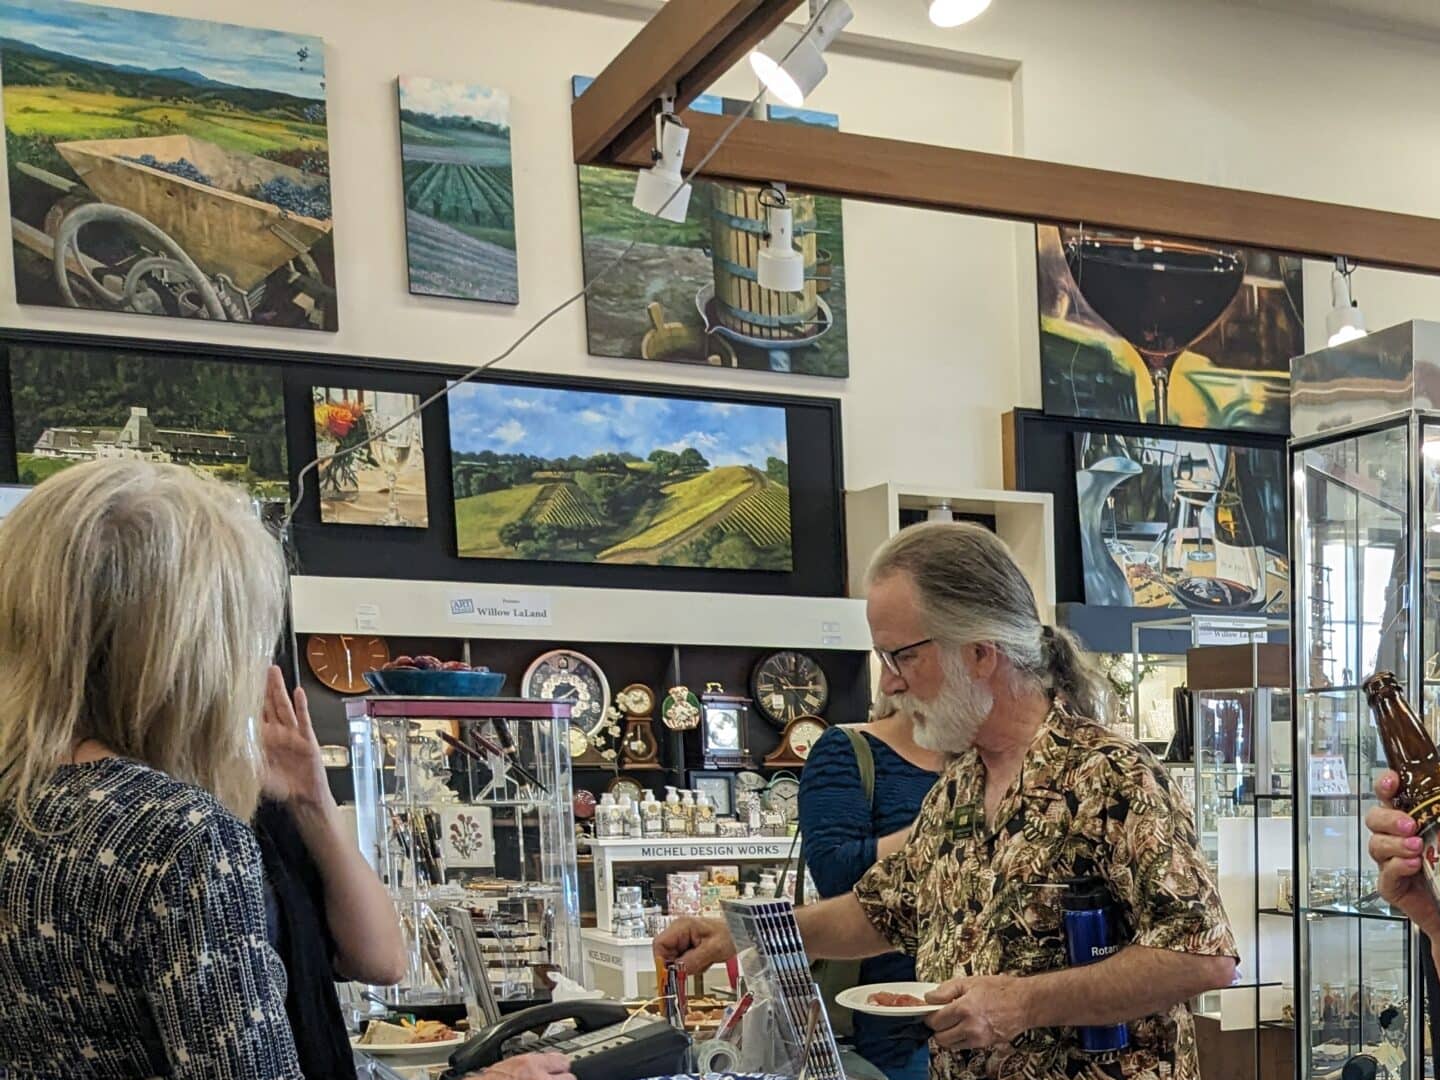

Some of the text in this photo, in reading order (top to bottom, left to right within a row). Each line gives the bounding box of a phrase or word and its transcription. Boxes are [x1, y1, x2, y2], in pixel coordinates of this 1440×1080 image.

[477, 608, 510, 617] Willow
[513, 609, 547, 618] LaLand
[1239, 631, 1264, 639] Land
[641, 845, 780, 857] MICHEL DESIGN WORKS
